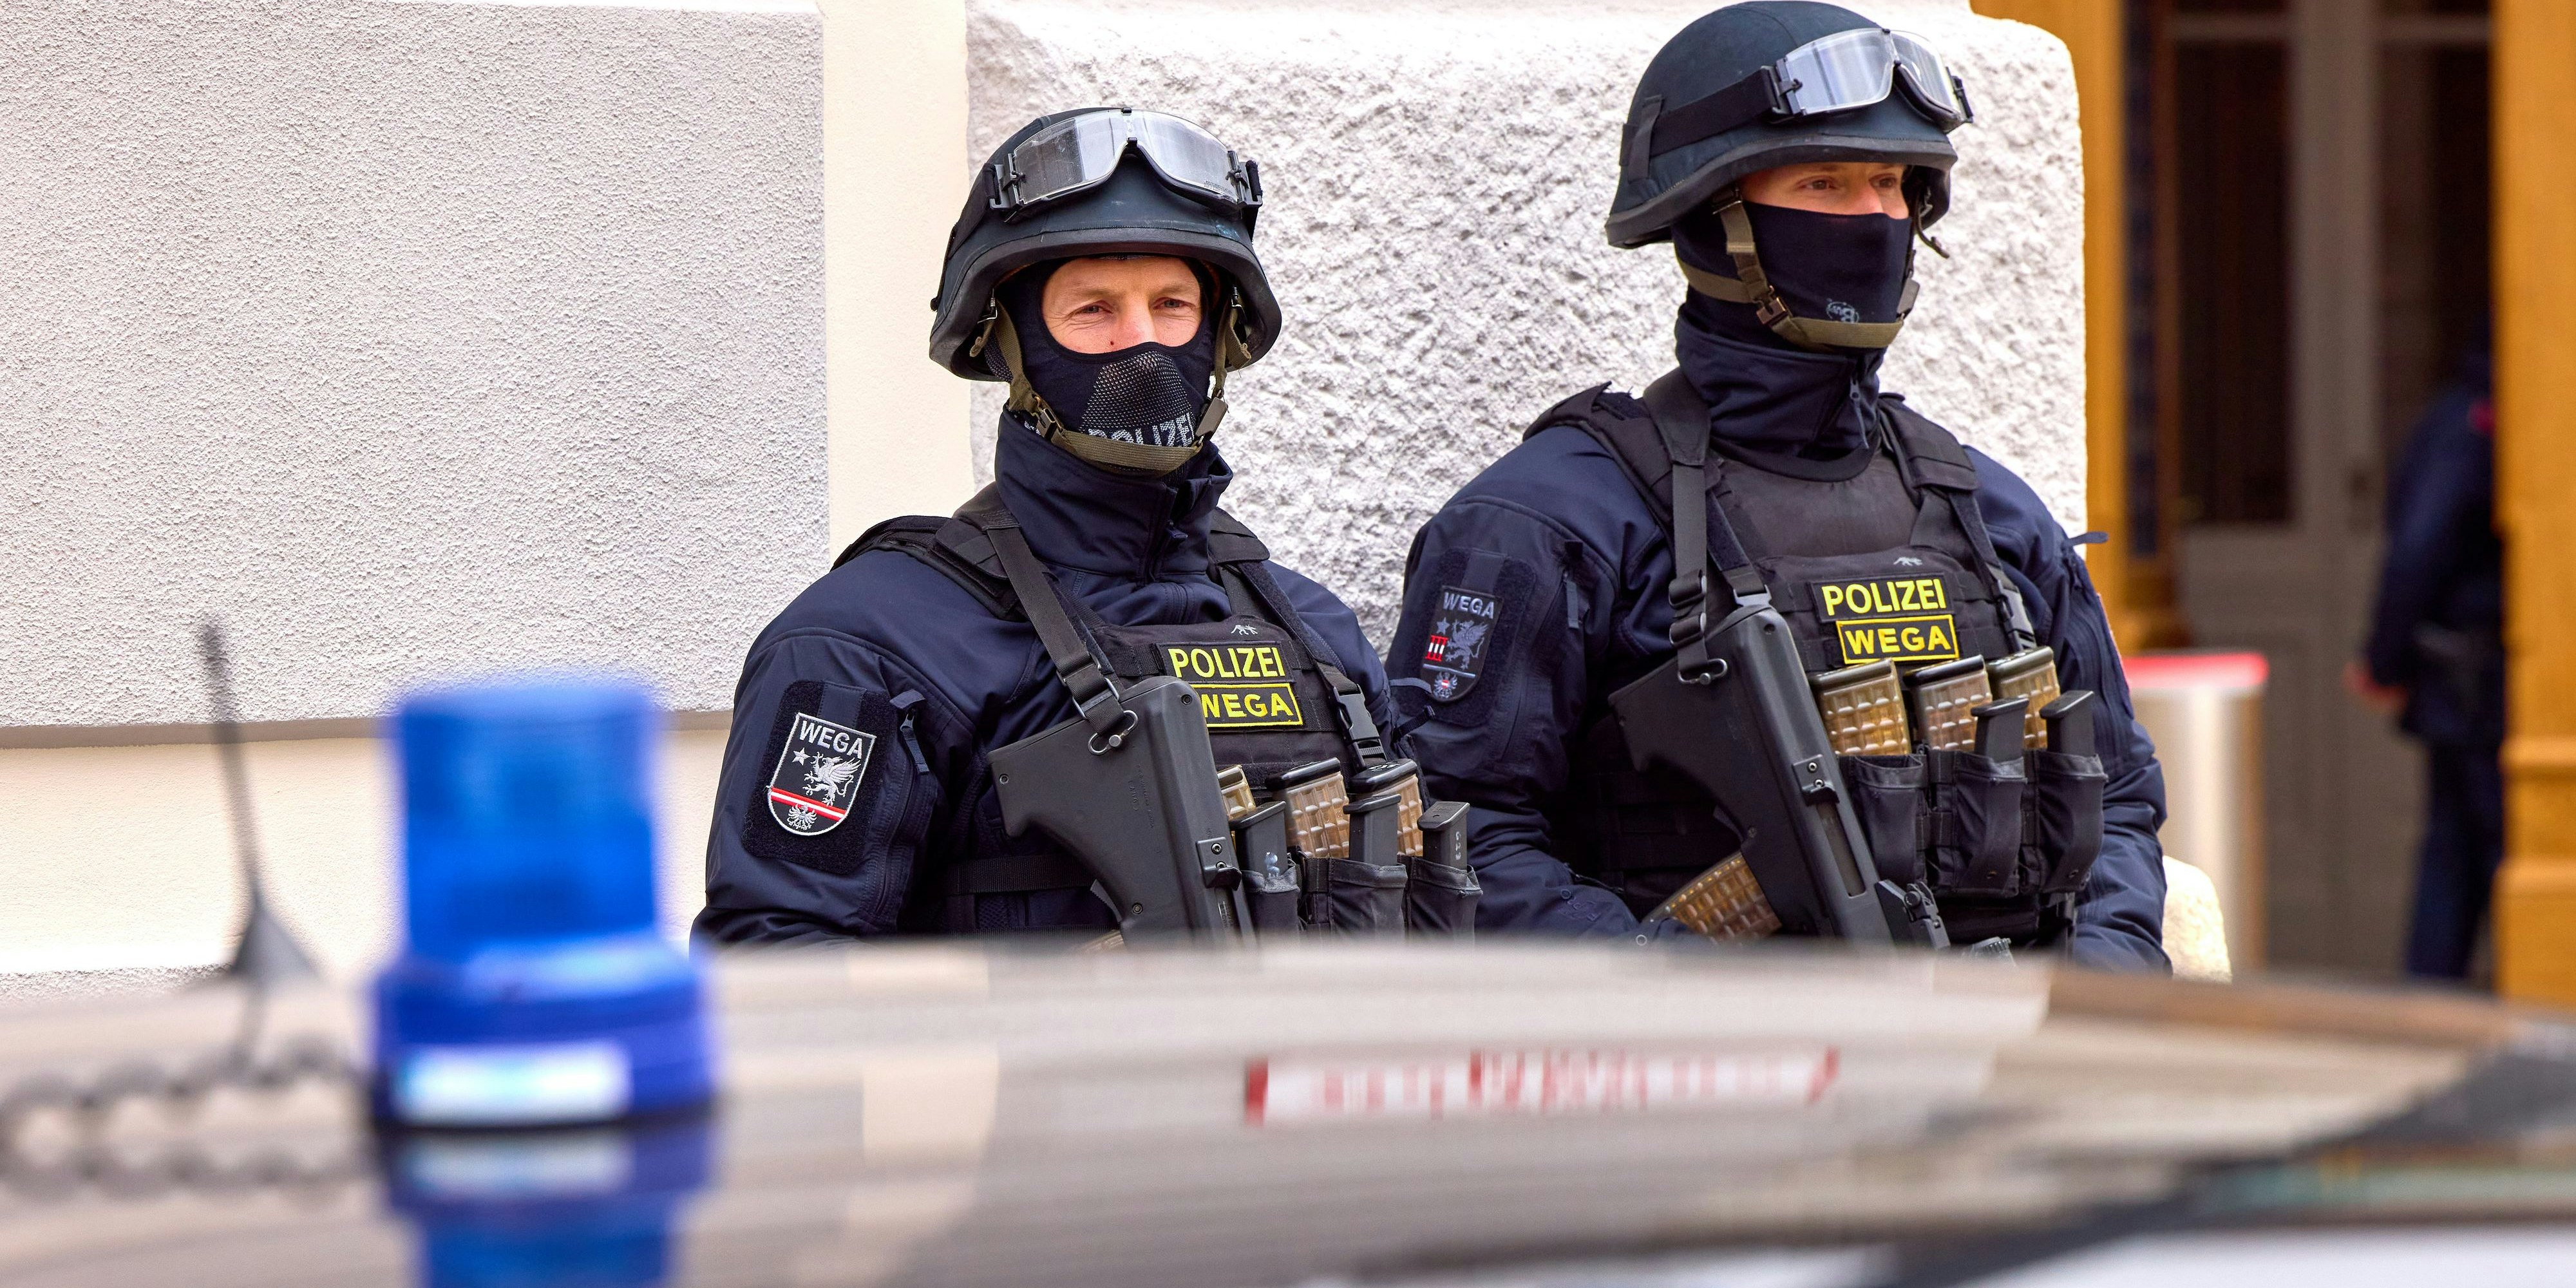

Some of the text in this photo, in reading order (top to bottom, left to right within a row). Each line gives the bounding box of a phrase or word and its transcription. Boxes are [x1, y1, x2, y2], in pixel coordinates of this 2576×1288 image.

[1088, 413, 1195, 447] IZEI
[1443, 592, 1495, 620] WEGA
[1821, 578, 1947, 616] POLIZEI
[1844, 625, 1951, 655] WEGA
[1168, 647, 1285, 678] POLIZEI
[799, 720, 863, 759] WEGA
